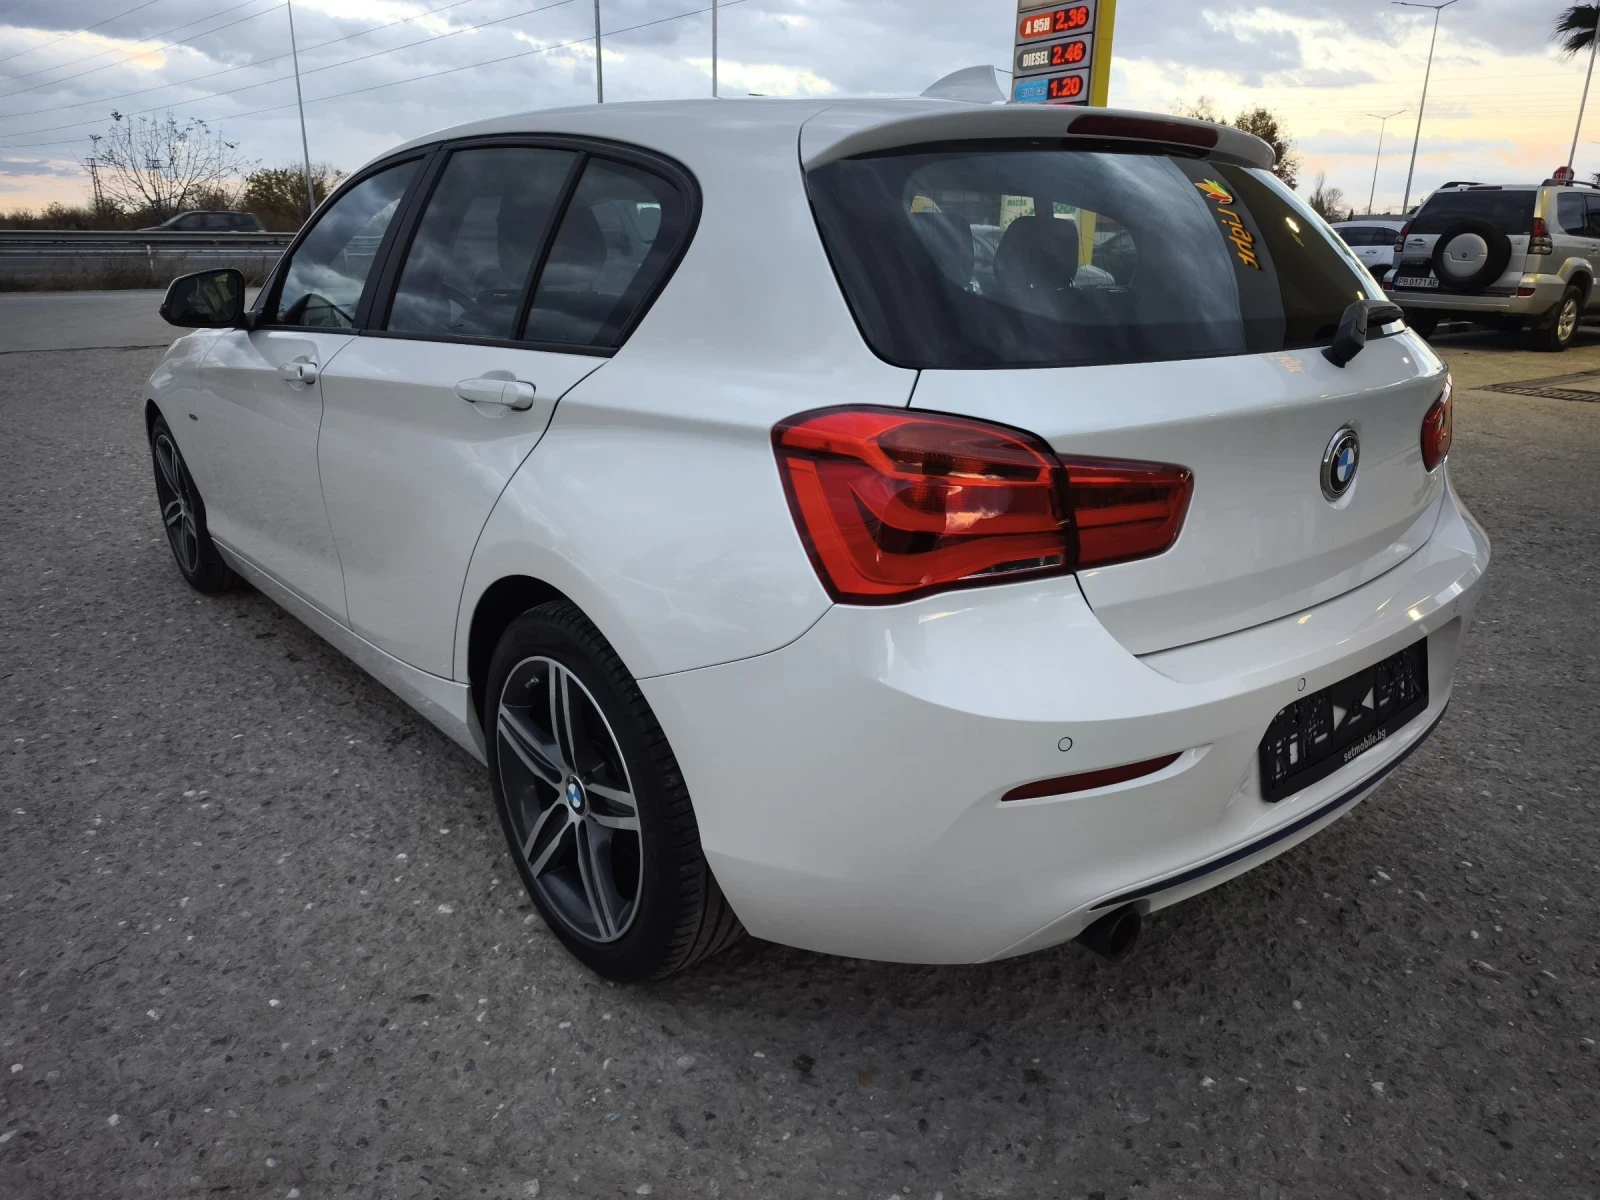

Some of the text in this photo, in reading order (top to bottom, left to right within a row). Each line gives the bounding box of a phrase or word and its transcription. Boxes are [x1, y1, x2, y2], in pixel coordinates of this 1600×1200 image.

[1022, 42, 1083, 67] DIESEL 2.46
[1050, 76, 1080, 97] 1.20
[1343, 728, 1387, 762] setmobile.bg
